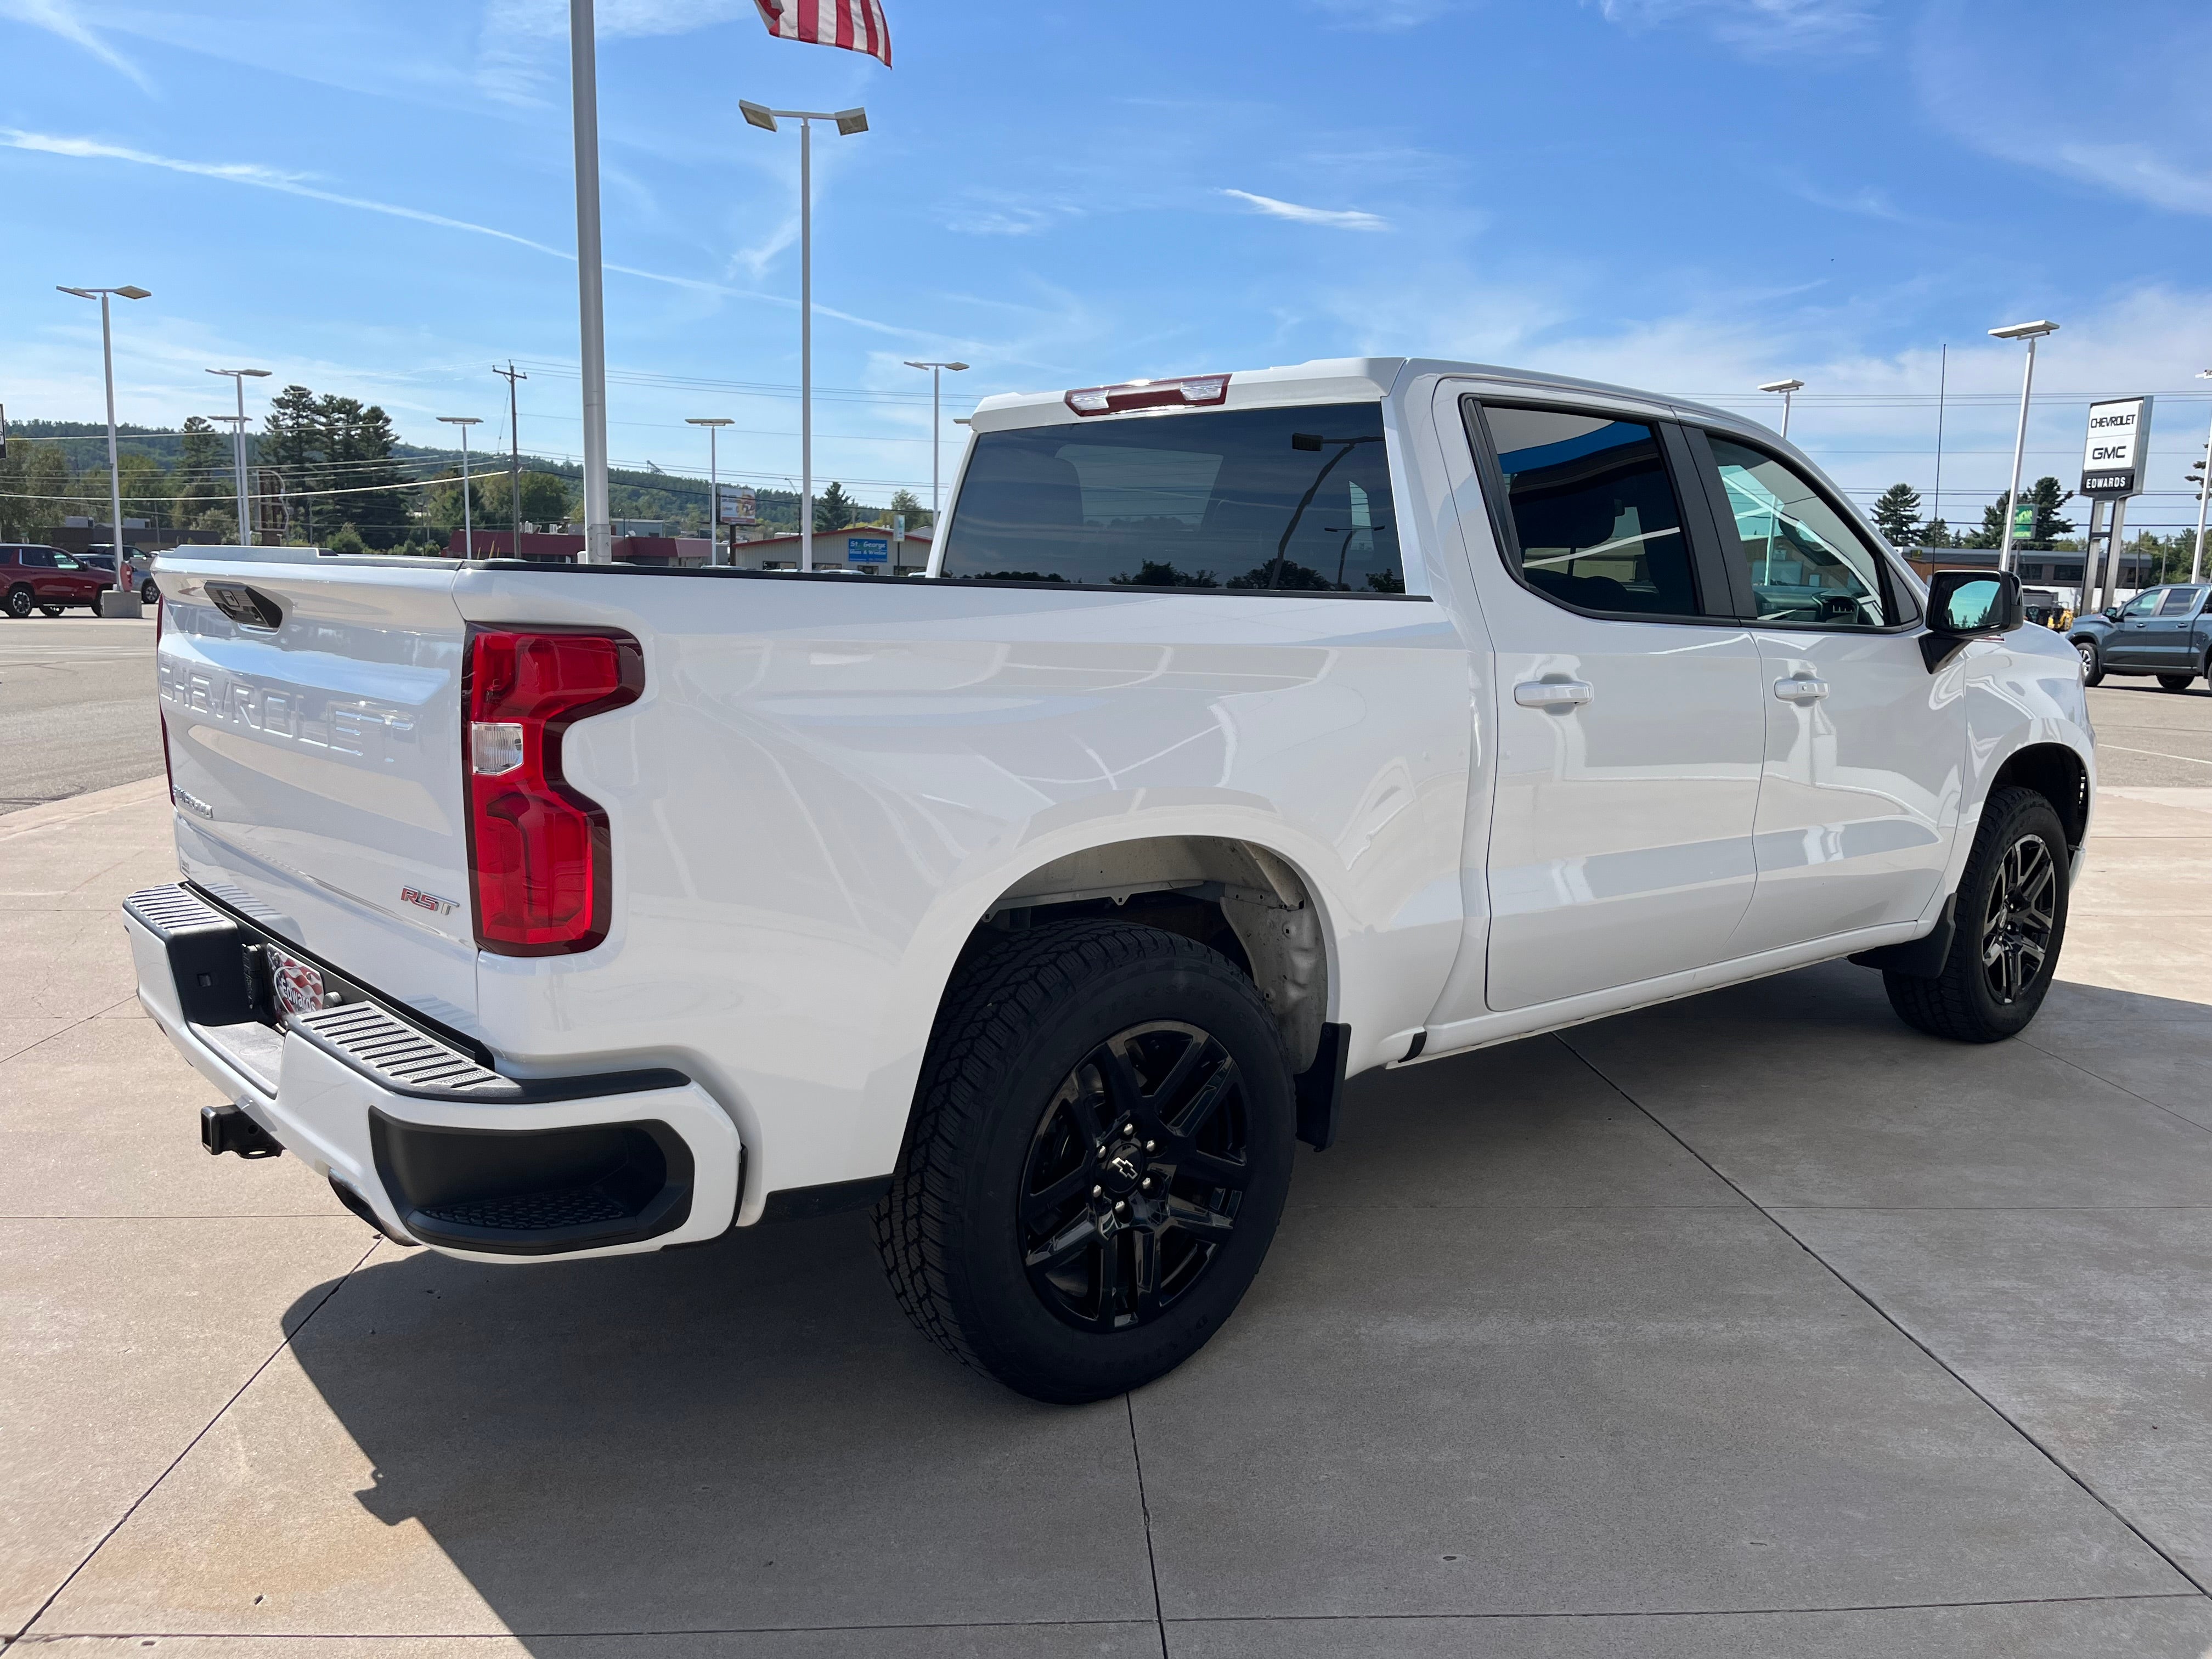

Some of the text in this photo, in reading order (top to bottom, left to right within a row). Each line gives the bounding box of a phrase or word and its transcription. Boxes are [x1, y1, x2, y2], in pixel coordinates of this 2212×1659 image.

[2091, 414, 2136, 428] CHEVROLET
[2092, 445, 2126, 460] GMC
[2086, 476, 2126, 488] EDWARDS
[863, 541, 886, 550] George
[159, 662, 418, 764] CHEVROLET
[401, 885, 460, 916] RST
[280, 978, 317, 1012] Edwards
